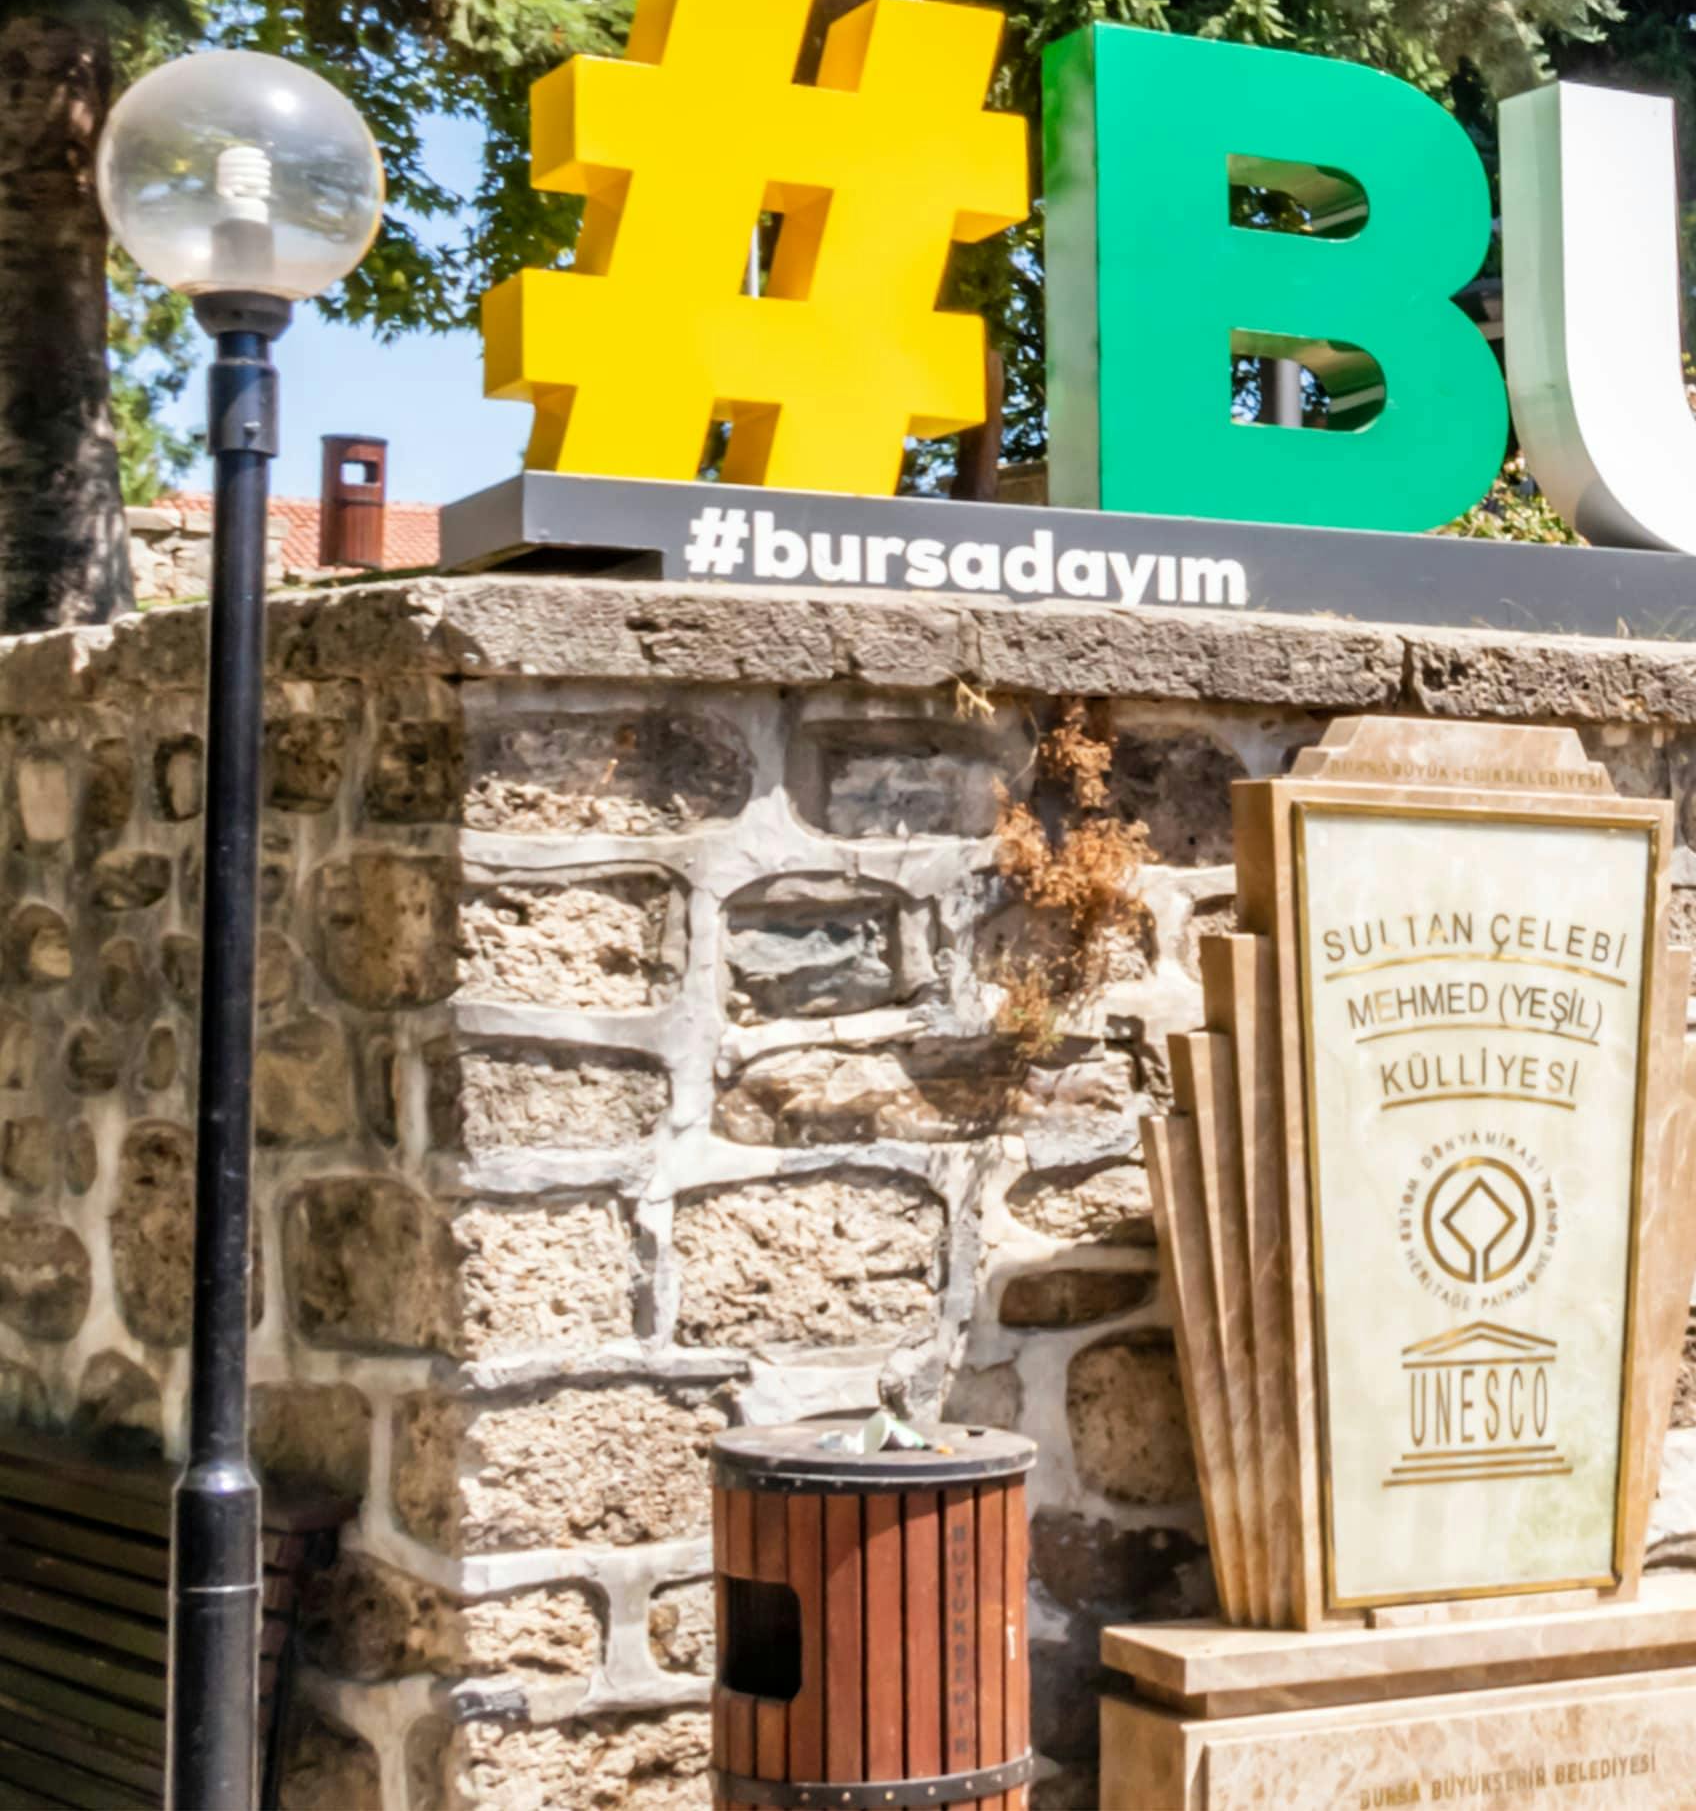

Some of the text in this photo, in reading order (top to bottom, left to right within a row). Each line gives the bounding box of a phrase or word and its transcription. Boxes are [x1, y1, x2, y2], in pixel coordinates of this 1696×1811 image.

[683, 506, 1248, 607] #bursadayım
[1323, 911, 1628, 969] SULTAN ÇELEBİ
[1346, 982, 1603, 1039] MEHMED (YEŞİL)
[1379, 1046, 1579, 1097] KÜLLİYESİ
[1409, 1366, 1549, 1448] UNESCO
